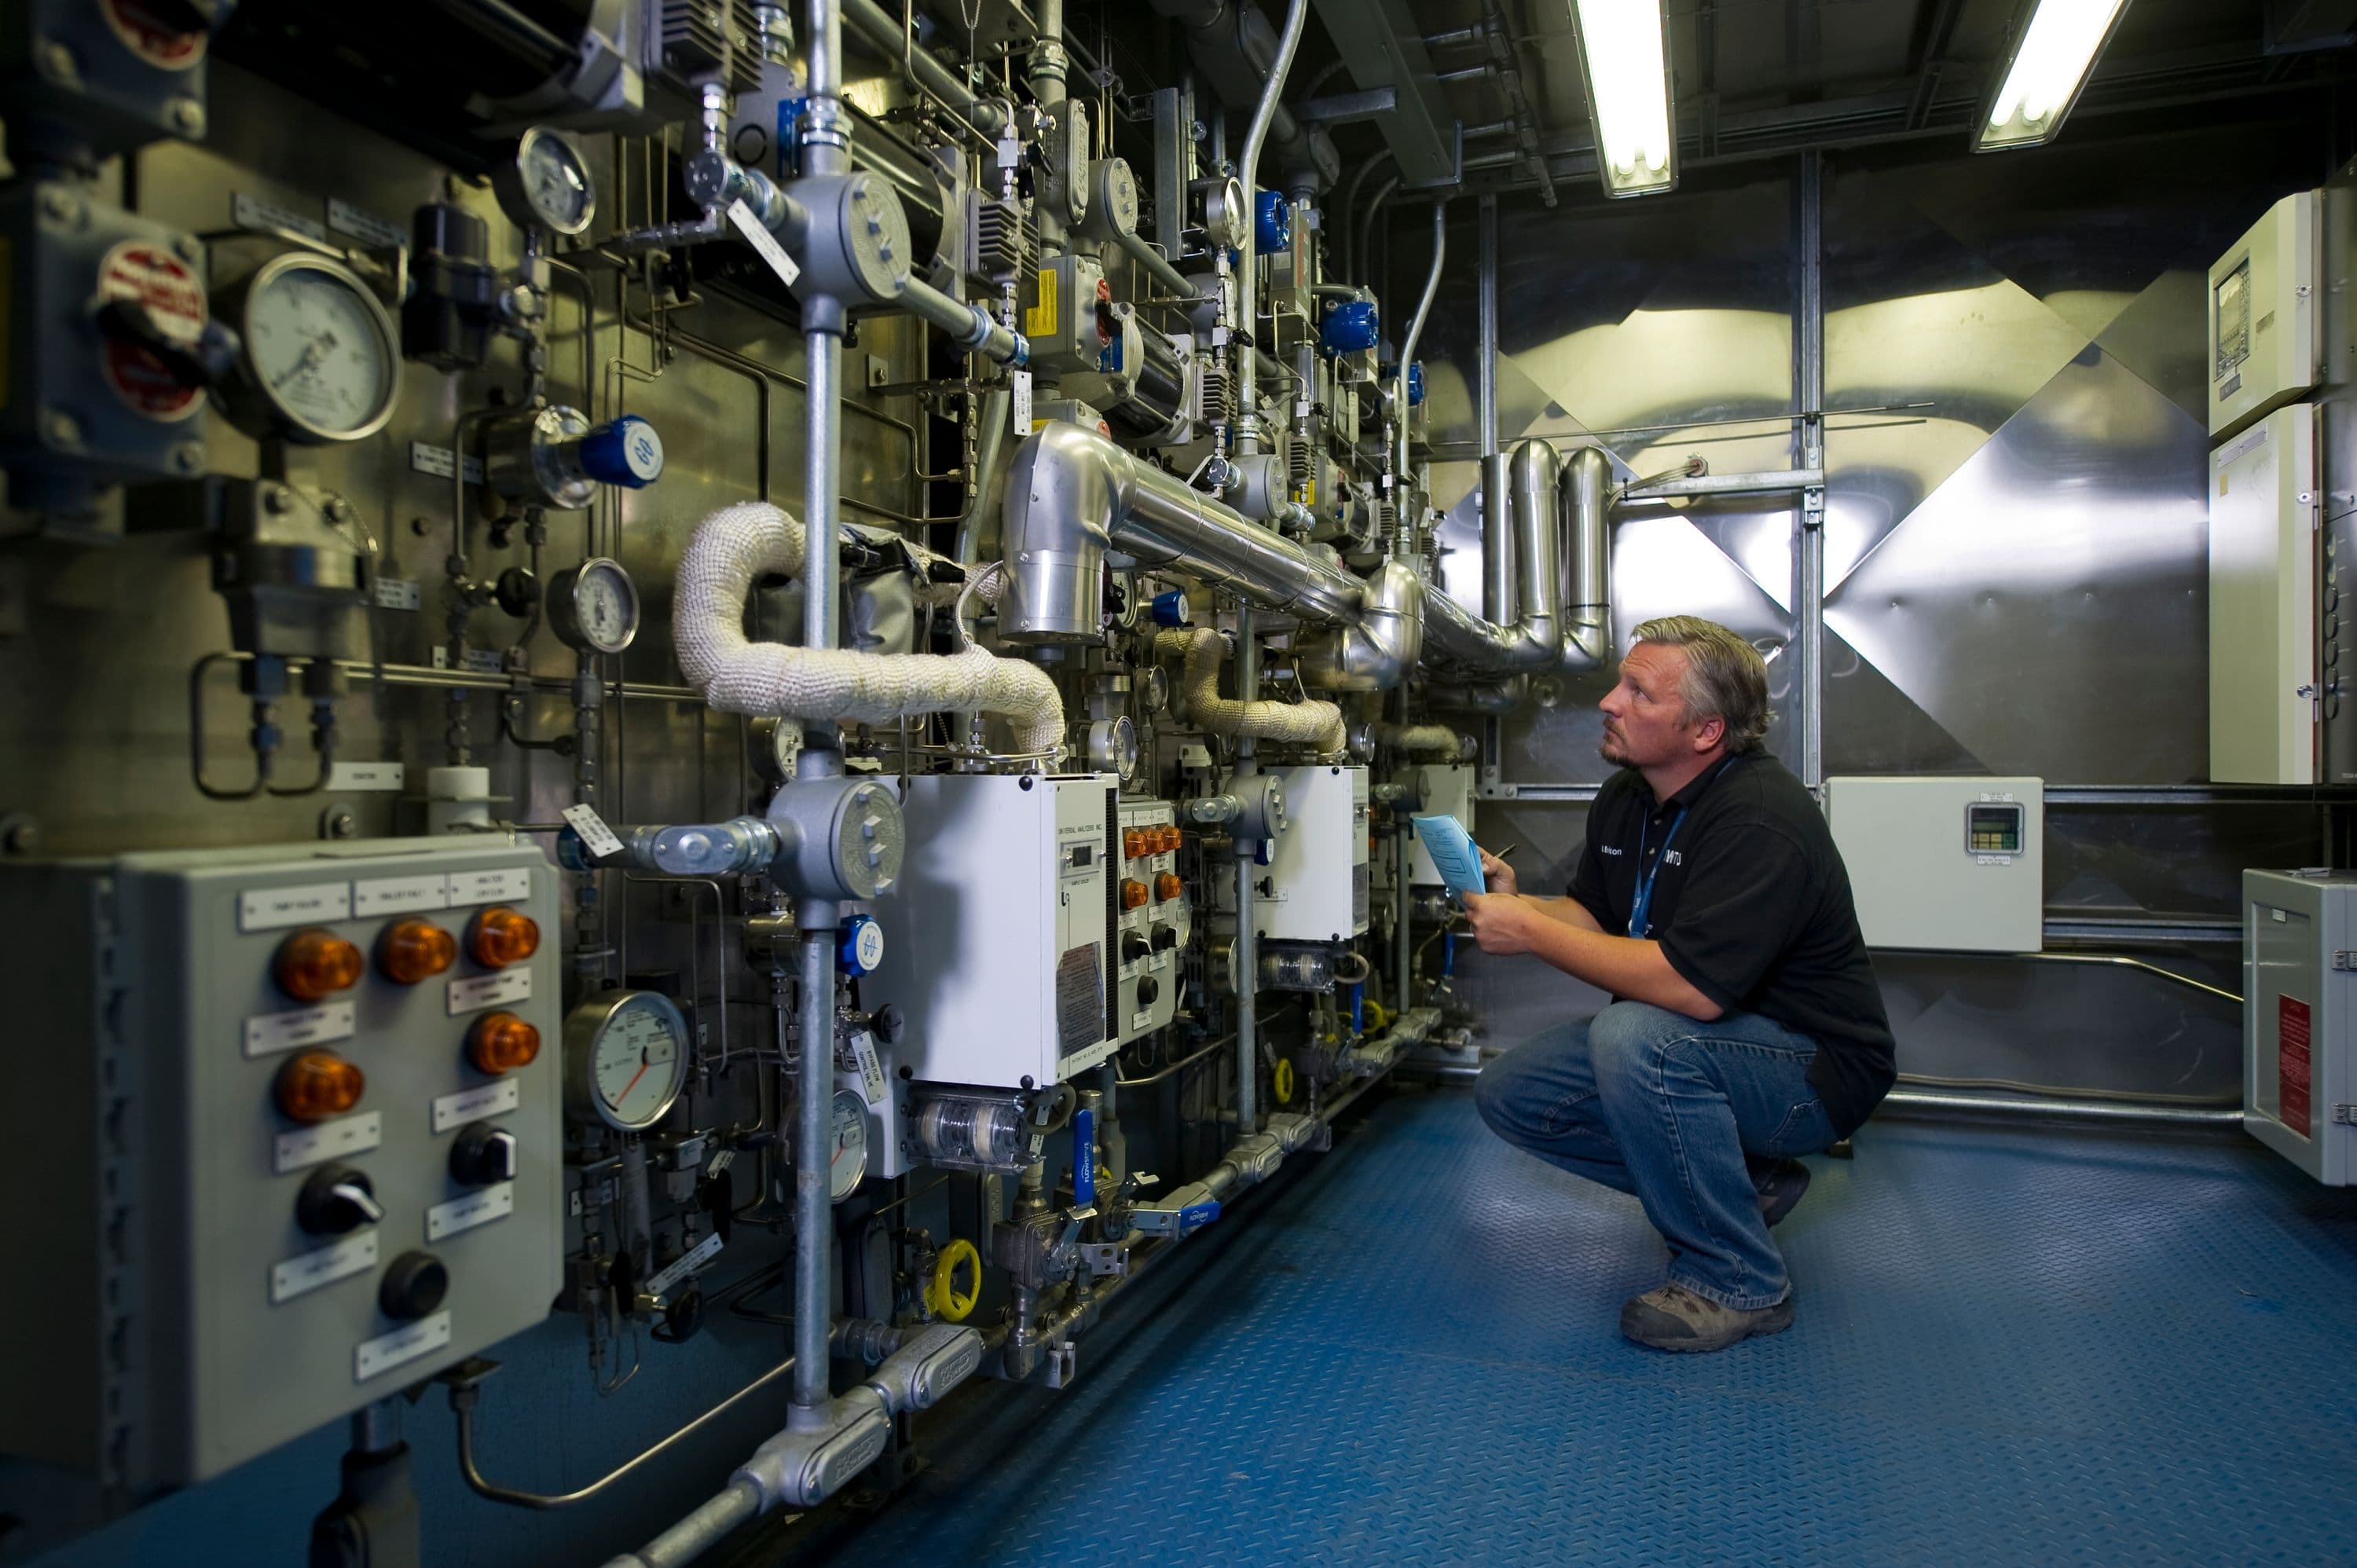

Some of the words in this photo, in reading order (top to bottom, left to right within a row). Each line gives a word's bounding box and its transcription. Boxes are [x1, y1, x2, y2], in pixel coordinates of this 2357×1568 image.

[859, 1051, 867, 1072] CONTROL
[865, 1072, 874, 1087] VALVE
[867, 1050, 876, 1070] BYPASS
